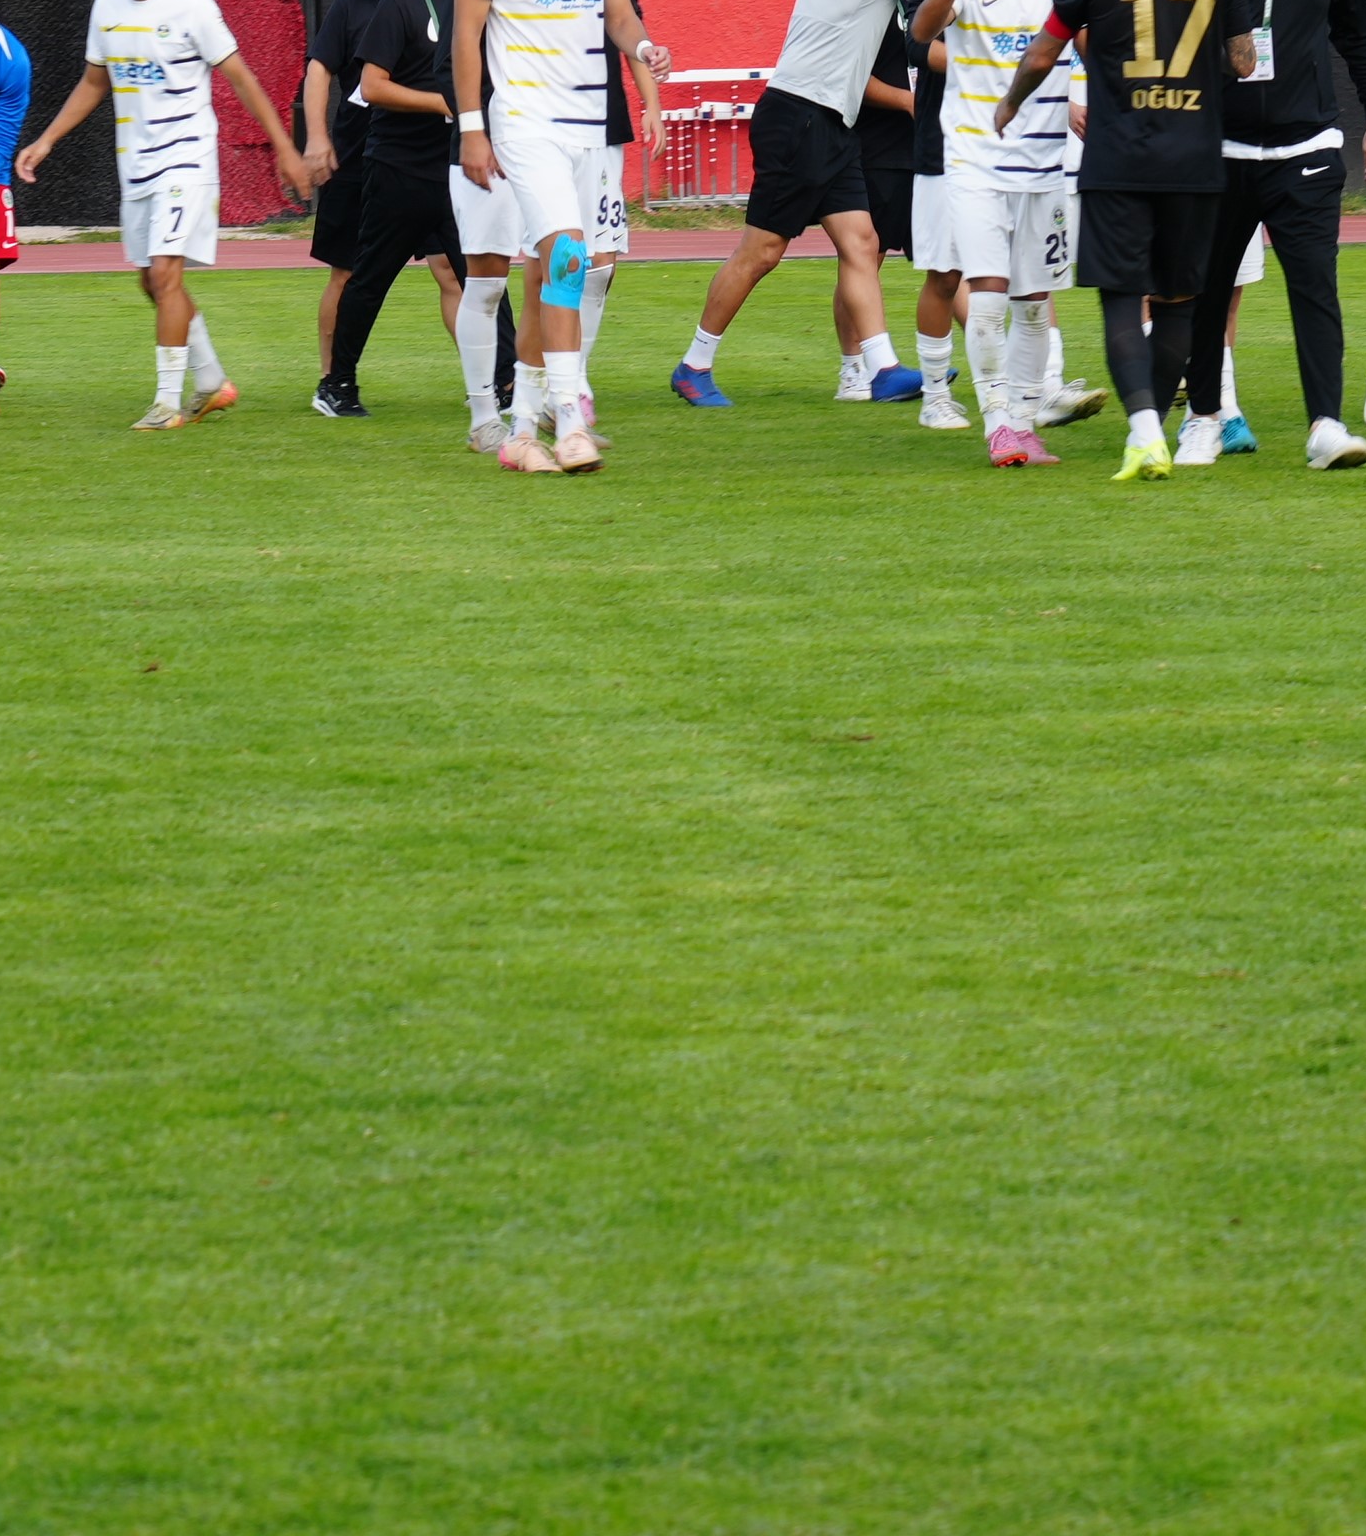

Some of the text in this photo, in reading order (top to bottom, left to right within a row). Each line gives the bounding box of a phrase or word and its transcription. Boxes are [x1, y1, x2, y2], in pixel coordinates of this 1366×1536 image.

[1131, 84, 1202, 111] OĞUZ
[4, 209, 14, 238] 1
[170, 206, 183, 233] 7
